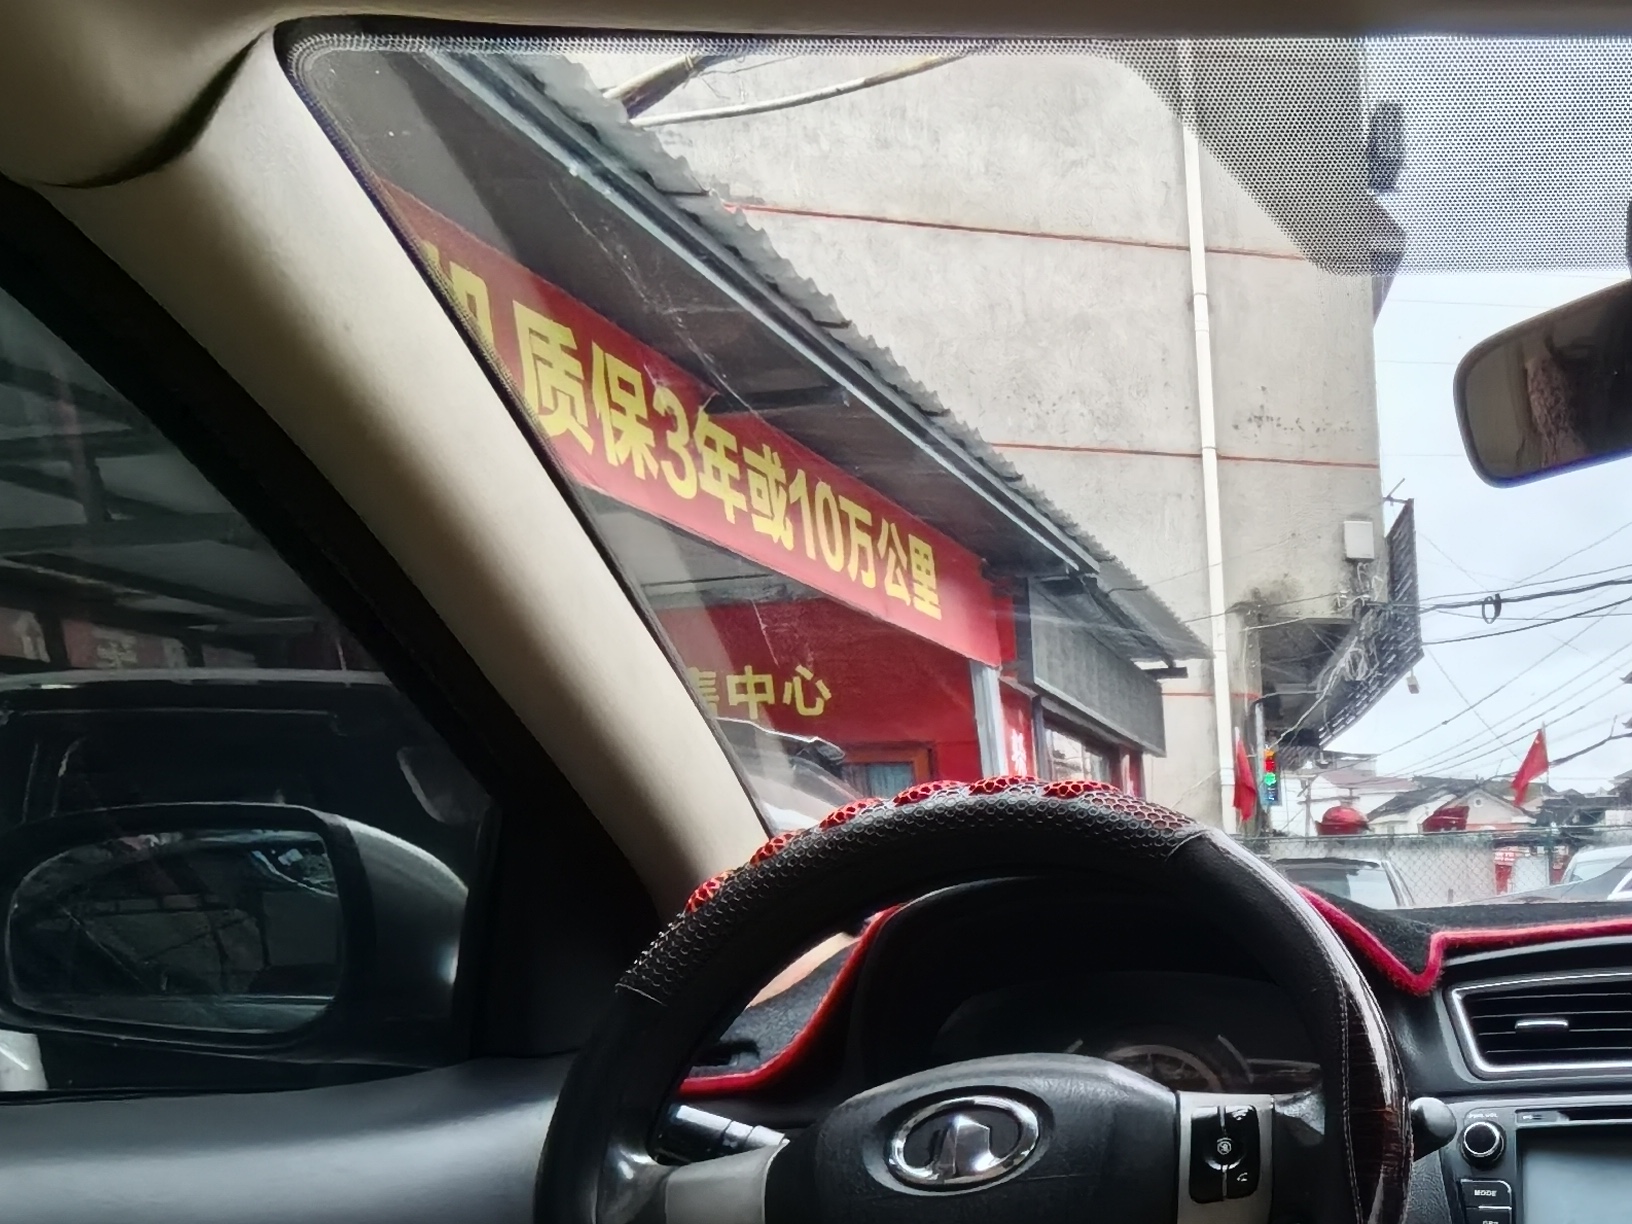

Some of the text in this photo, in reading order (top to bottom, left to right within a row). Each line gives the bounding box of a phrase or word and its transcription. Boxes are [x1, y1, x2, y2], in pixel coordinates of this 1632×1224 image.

[422, 240, 943, 621] 质保3年或10万公里
[1473, 1189, 1498, 1197] MODE
